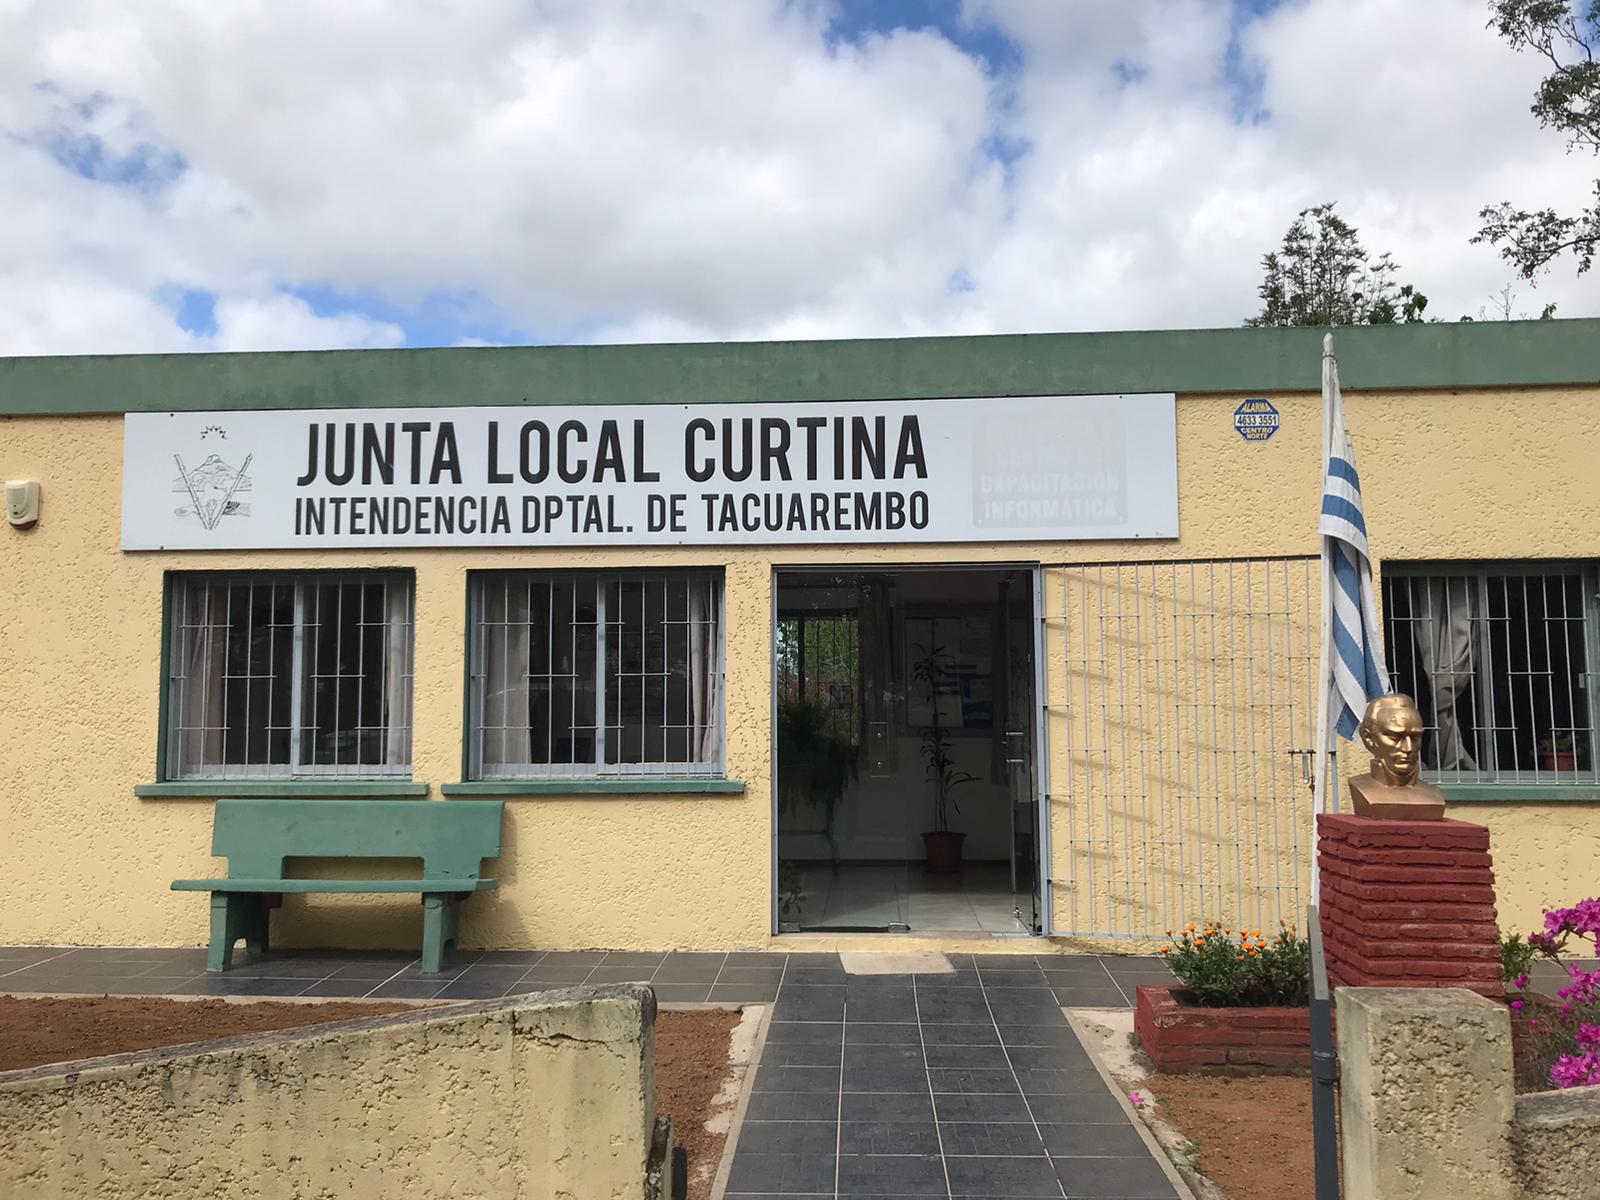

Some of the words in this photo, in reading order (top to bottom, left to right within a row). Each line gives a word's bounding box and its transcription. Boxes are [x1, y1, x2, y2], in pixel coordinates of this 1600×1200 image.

[1237, 415, 1257, 426] 4633
[1258, 415, 1277, 426] 3551
[1241, 402, 1274, 413] ALARMA
[296, 422, 463, 487] JUNTA
[488, 419, 661, 484] LOCAL
[685, 415, 928, 483] CURTINA
[295, 495, 511, 536] INTENDENCIA
[523, 494, 633, 534] DPTAL.
[648, 493, 687, 533] DE
[701, 491, 930, 532] TACUAREMBO
